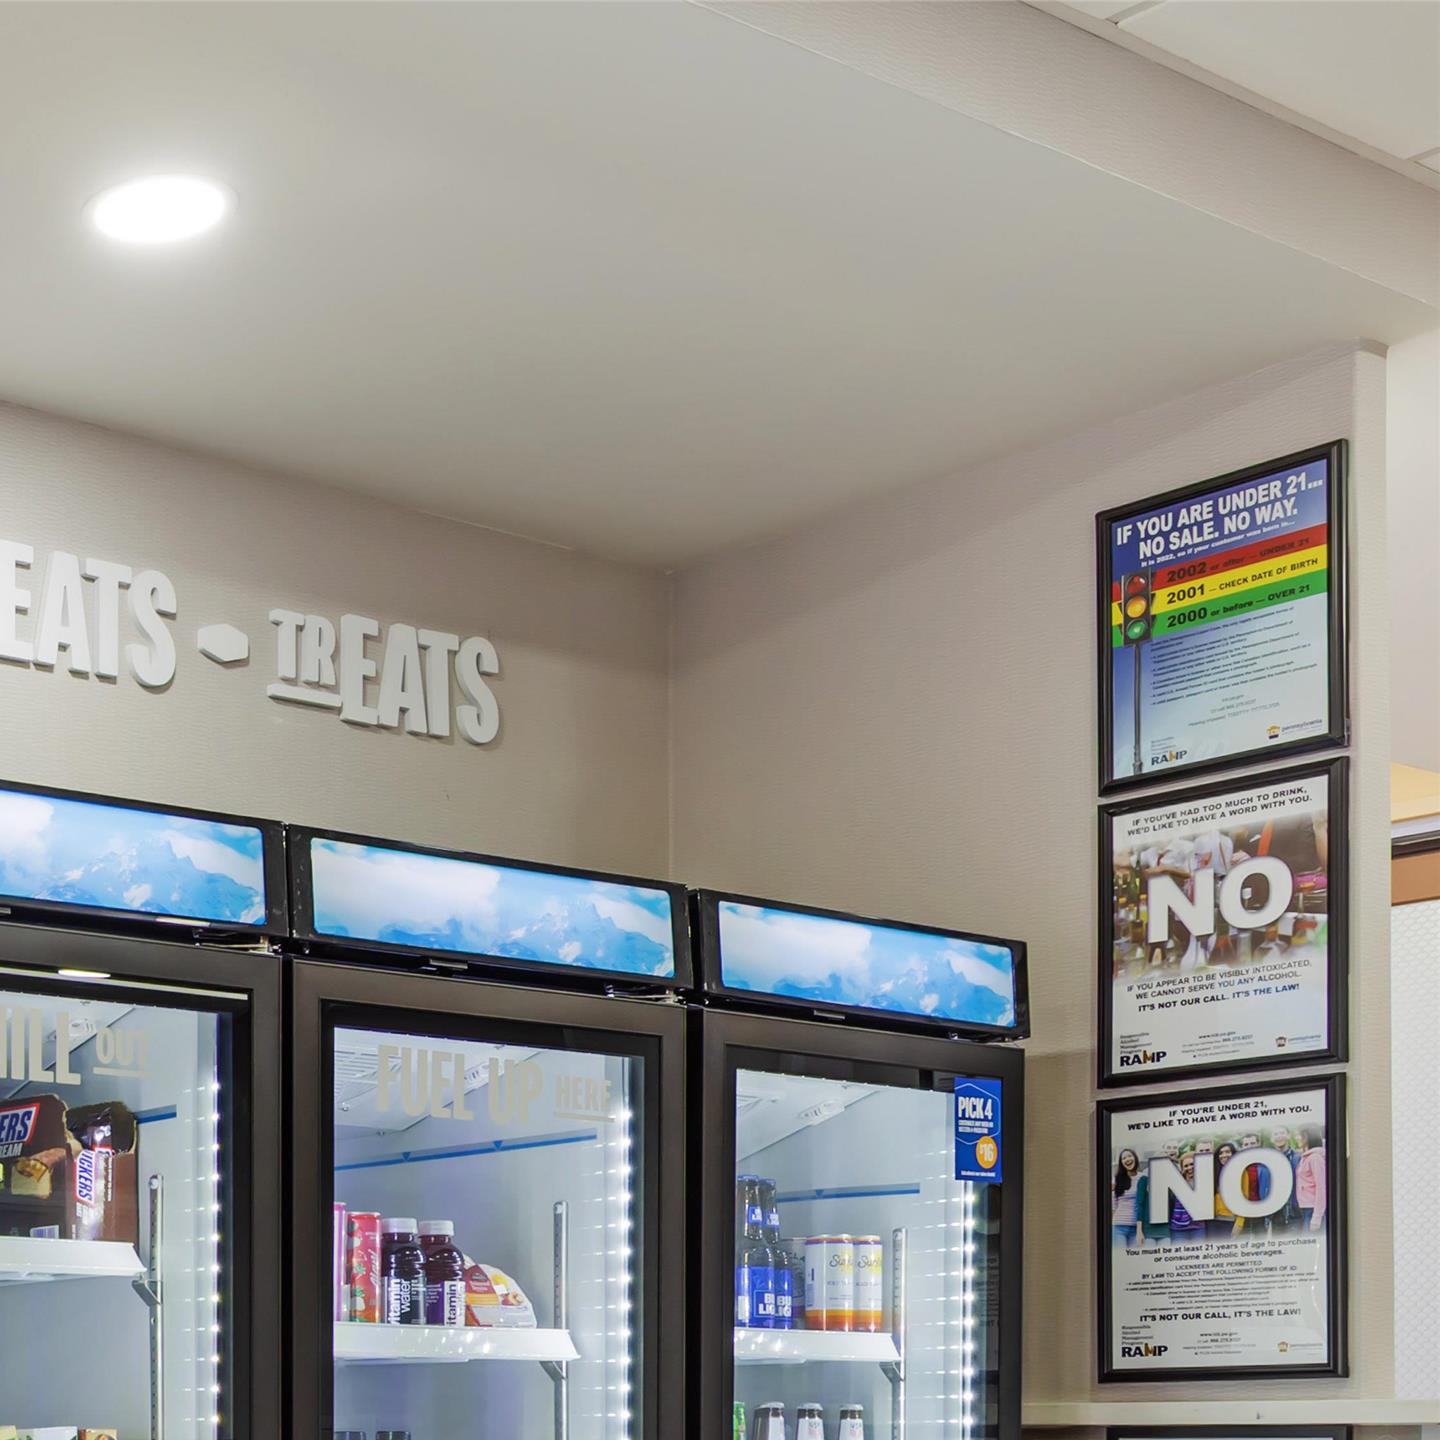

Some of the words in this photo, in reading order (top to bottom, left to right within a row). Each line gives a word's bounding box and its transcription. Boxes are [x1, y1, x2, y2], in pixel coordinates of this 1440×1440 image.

[1117, 525, 1132, 545] IF
[1137, 512, 1172, 538] YOU
[1177, 501, 1213, 527] ARE
[1218, 480, 1282, 514] UNDER
[1139, 537, 1164, 559] NO
[1169, 521, 1219, 550] SALE.
[1224, 512, 1250, 535] NO
[1255, 497, 1297, 525] WAY.
[1167, 584, 1204, 604] 2001
[1220, 575, 1248, 590] CHECK
[1252, 569, 1273, 581] DATE
[1277, 566, 1287, 575] OF
[1290, 558, 1318, 570] BIRTH
[1167, 608, 1207, 627] 2000
[1223, 600, 1253, 613] before
[1268, 588, 1295, 601] OVER
[1299, 585, 1310, 593] 21
[267, 608, 501, 744] TREATS
[1151, 750, 1187, 765] RAMP
[1128, 827, 1150, 836] WE'D
[1153, 822, 1173, 832] LIKE
[1177, 819, 1189, 827] TO
[1192, 813, 1216, 824] HAVE
[1229, 805, 1258, 816] WORD
[1261, 801, 1285, 810] WITH
[1290, 795, 1312, 804] YOU.
[1147, 856, 1293, 943] NO
[1136, 992, 1148, 1000] WE
[1151, 987, 1185, 997] CANNOT
[1188, 983, 1215, 992] SERVE
[1218, 980, 1235, 988] YOU
[1237, 977, 1255, 985] ANY
[96, 1027, 153, 1067] OUT
[1120, 1051, 1166, 1066] RAMP
[376, 1044, 473, 1122] FUEL
[488, 1057, 543, 1125] UP
[554, 1074, 613, 1111] HERE
[958, 1096, 984, 1119] PICK
[985, 1099, 992, 1120] 4
[1153, 1119, 1173, 1128] LIKE
[1192, 1115, 1216, 1124] HAVE
[1229, 1111, 1258, 1119] WORD
[1181, 1107, 1214, 1116] YOU'RE
[1218, 1103, 1250, 1112] UNDER
[1148, 1148, 1293, 1224] NO
[1121, 1345, 1168, 1357] RAMP
